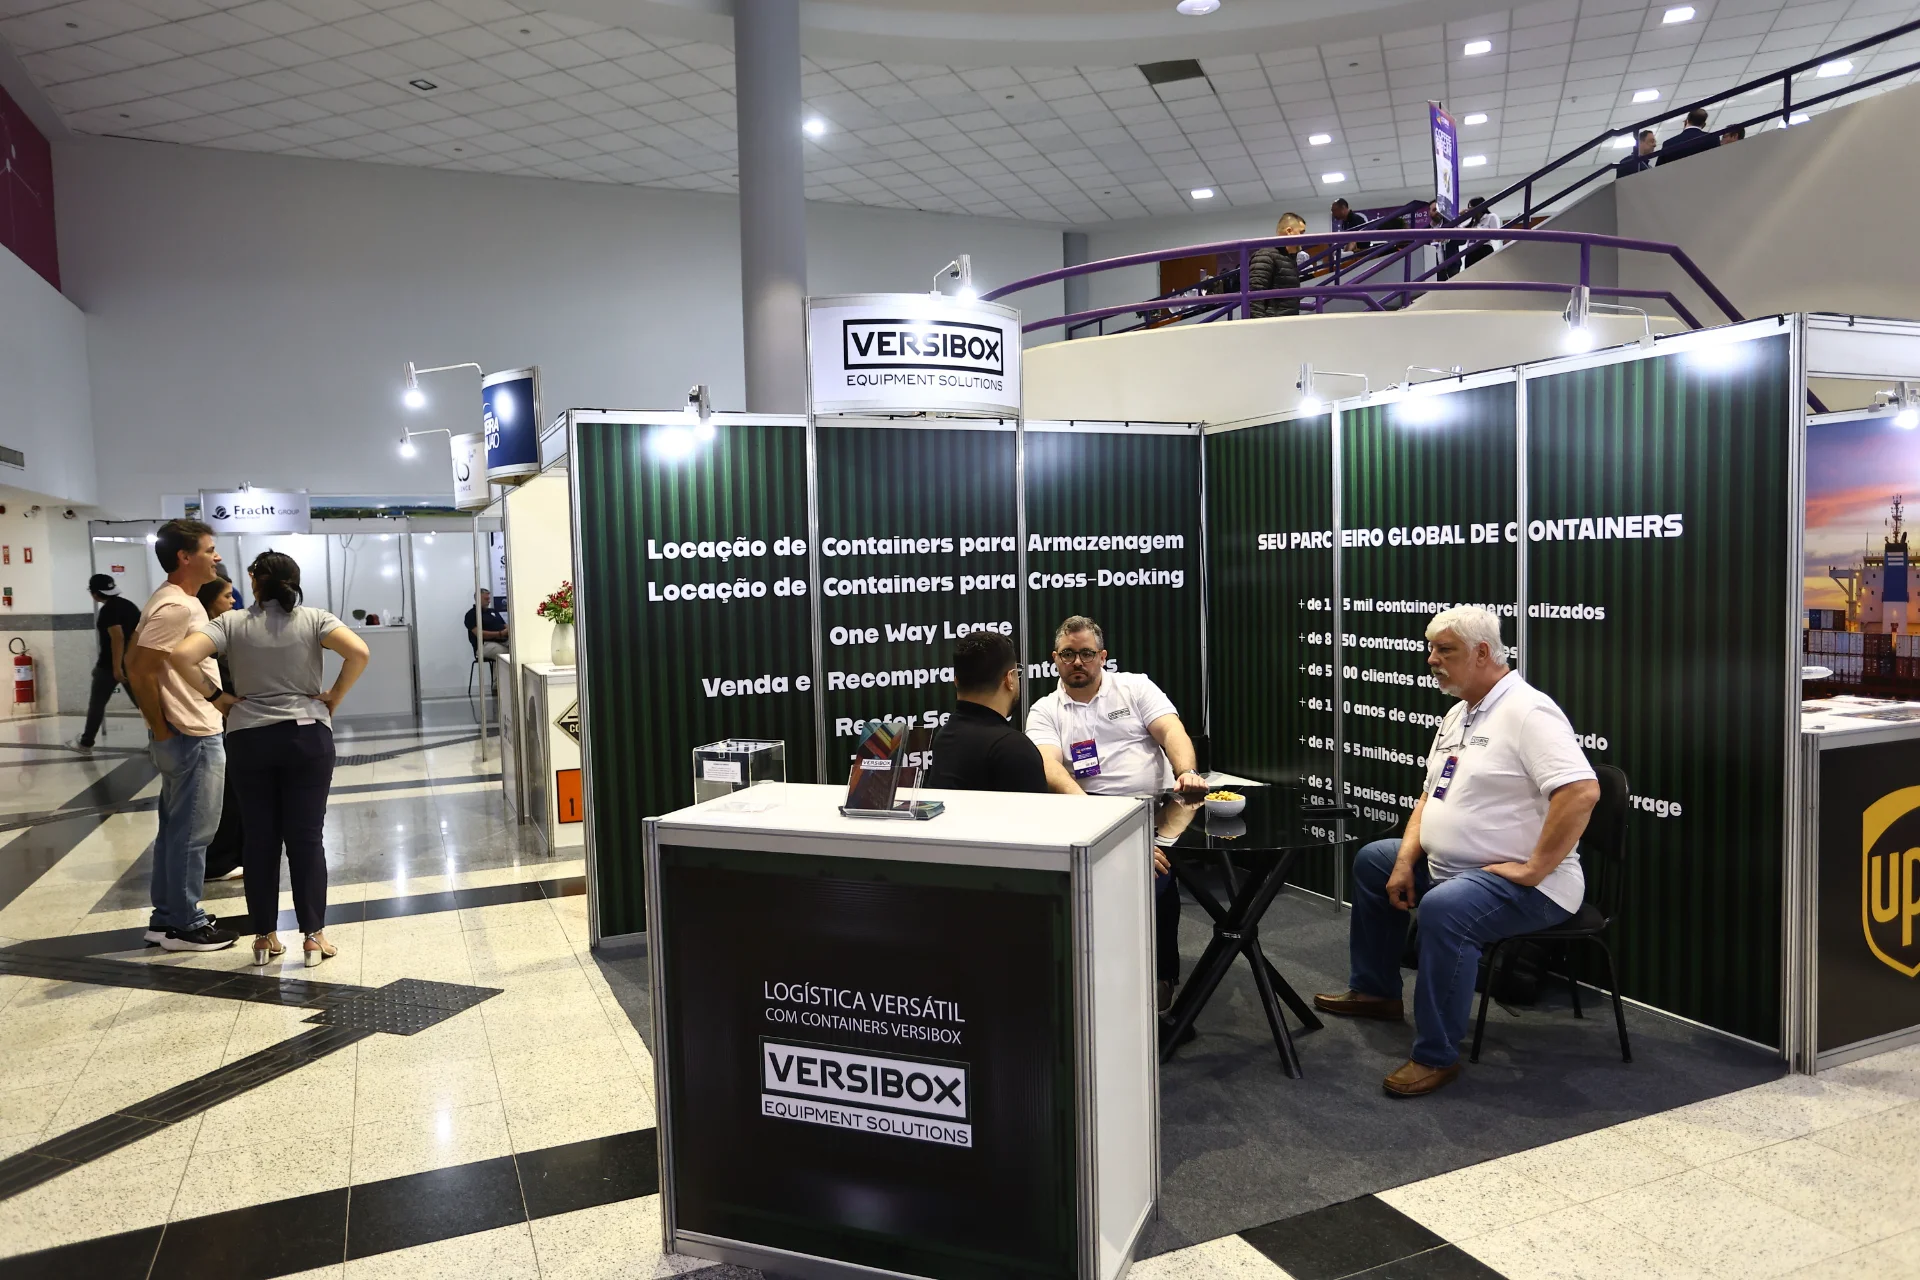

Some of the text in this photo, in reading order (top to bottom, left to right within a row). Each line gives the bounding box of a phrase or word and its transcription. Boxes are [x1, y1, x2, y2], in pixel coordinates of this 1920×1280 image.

[851, 331, 1000, 362] VERSIBOX
[847, 374, 1003, 391] EQUIPMENT SOLUTIONS
[234, 505, 275, 515] Fracht
[1258, 533, 1287, 550] SEU
[1388, 525, 1465, 546] GLOBAL
[1470, 523, 1499, 543] DE
[1504, 514, 1683, 543] CONTAINERS
[648, 534, 1184, 562] Locação de Containers para Armazenagem
[648, 568, 1184, 603] Locação de Containers para Cross-Docking
[1307, 598, 1322, 611] de
[1354, 598, 1373, 612] mil
[1376, 600, 1450, 614] containers
[829, 621, 1013, 645] One Way Lease
[1307, 632, 1322, 645] de
[1359, 636, 1424, 652] contratos
[702, 667, 955, 697] Venda e Recompra
[1308, 663, 1323, 676] de
[1361, 669, 1414, 686] clientes
[1308, 697, 1323, 710] de
[1354, 703, 1385, 718] anos
[1388, 707, 1405, 722] de
[1308, 735, 1323, 748] de
[1361, 746, 1413, 766] milhões
[1308, 775, 1322, 789] de
[1872, 847, 1920, 947] up
[764, 980, 965, 1023] LOGÍSTICA VERSÁTIL
[765, 1008, 961, 1045] COM CONTAINERS VERSIBOX
[768, 1052, 961, 1108] VERSIBOX
[764, 1101, 968, 1144] EQUIPMENT SOLUTIONS
